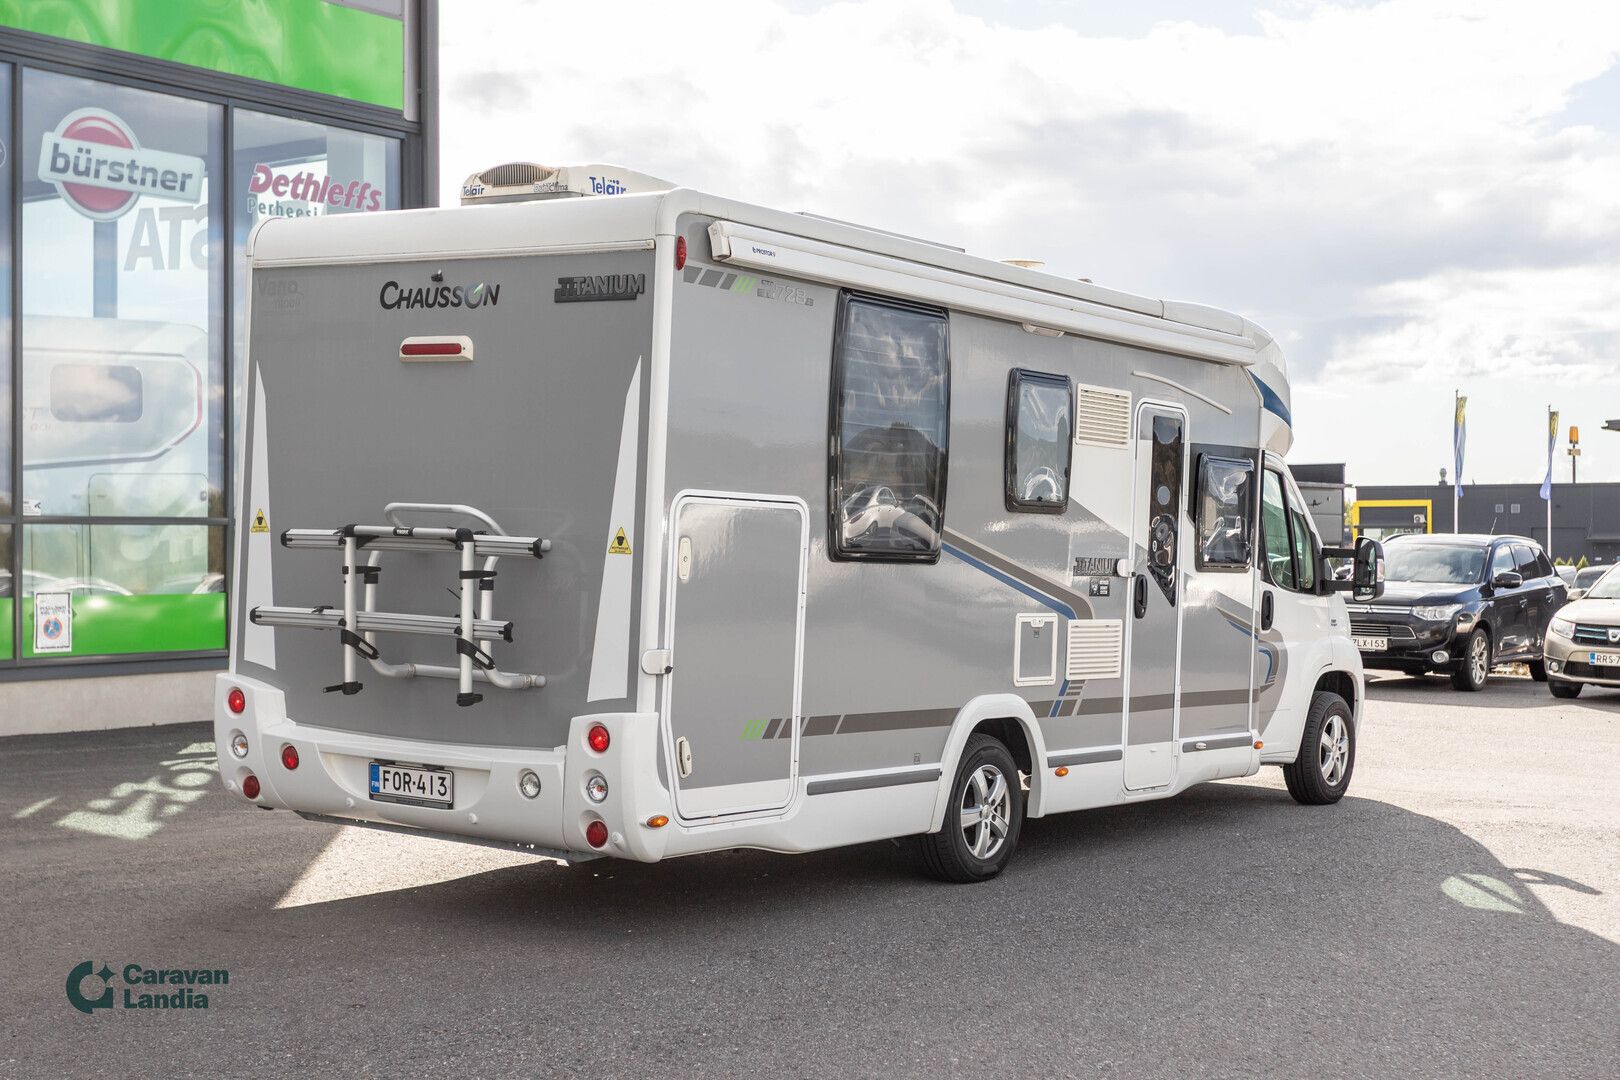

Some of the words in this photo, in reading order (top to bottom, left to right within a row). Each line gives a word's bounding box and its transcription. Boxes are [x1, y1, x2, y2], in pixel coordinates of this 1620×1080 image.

[50, 143, 193, 193] bürstner
[250, 163, 383, 212] Dethleffs
[380, 280, 500, 310] CHAUSSON
[557, 273, 645, 300] TITANIUM
[382, 769, 448, 797] FOR-413
